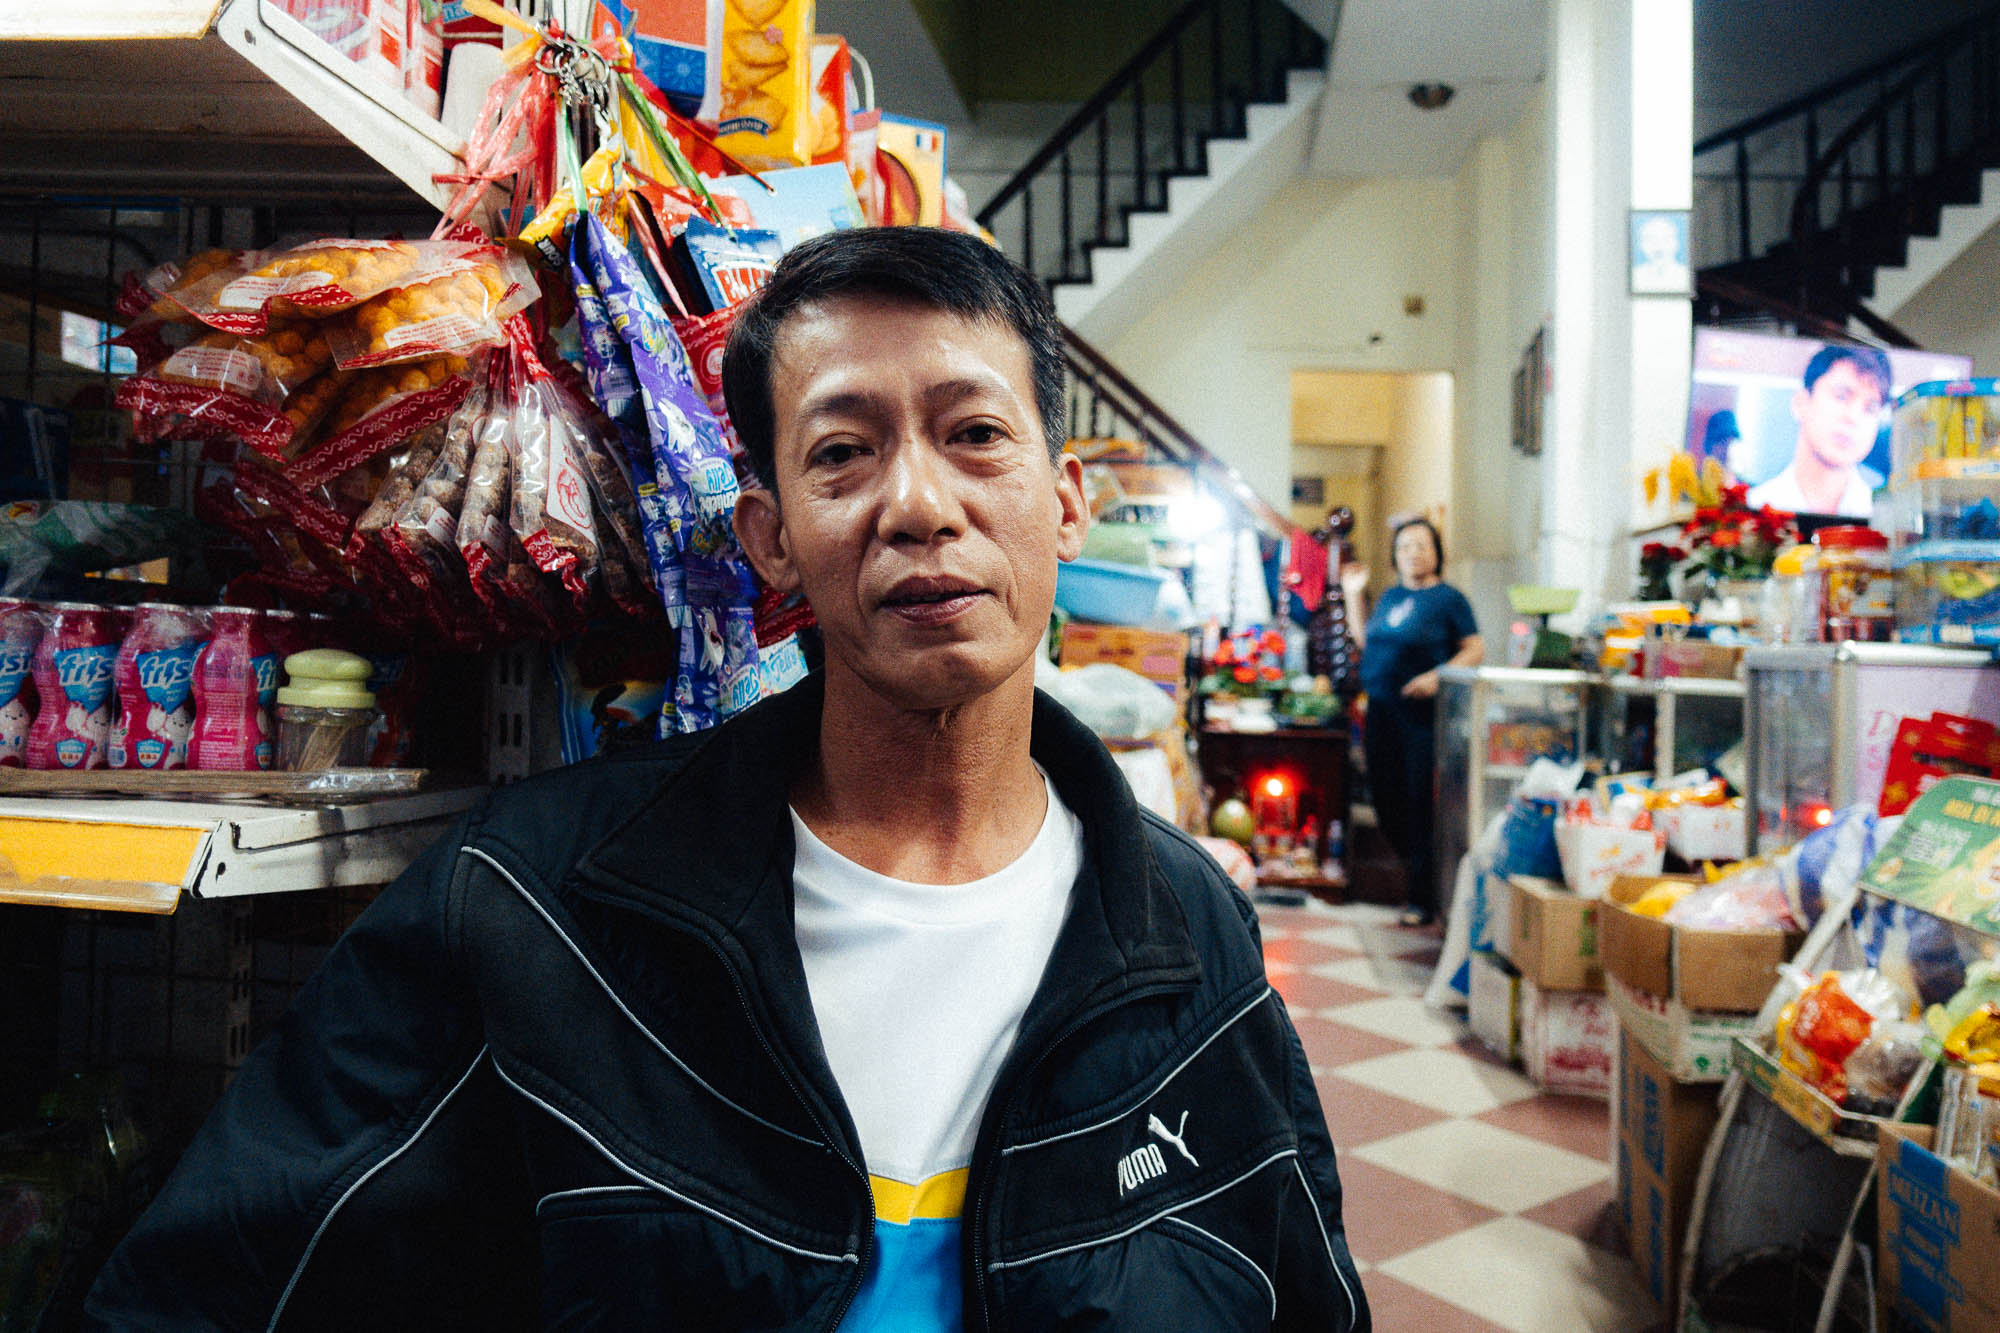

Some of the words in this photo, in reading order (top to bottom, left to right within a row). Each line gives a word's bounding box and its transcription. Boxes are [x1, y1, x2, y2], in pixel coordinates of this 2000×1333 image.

[705, 462, 737, 493] Jelly
[770, 647, 797, 684] Jelly
[732, 667, 759, 709] Jelly
[1118, 1144, 1167, 1196] PUMA
